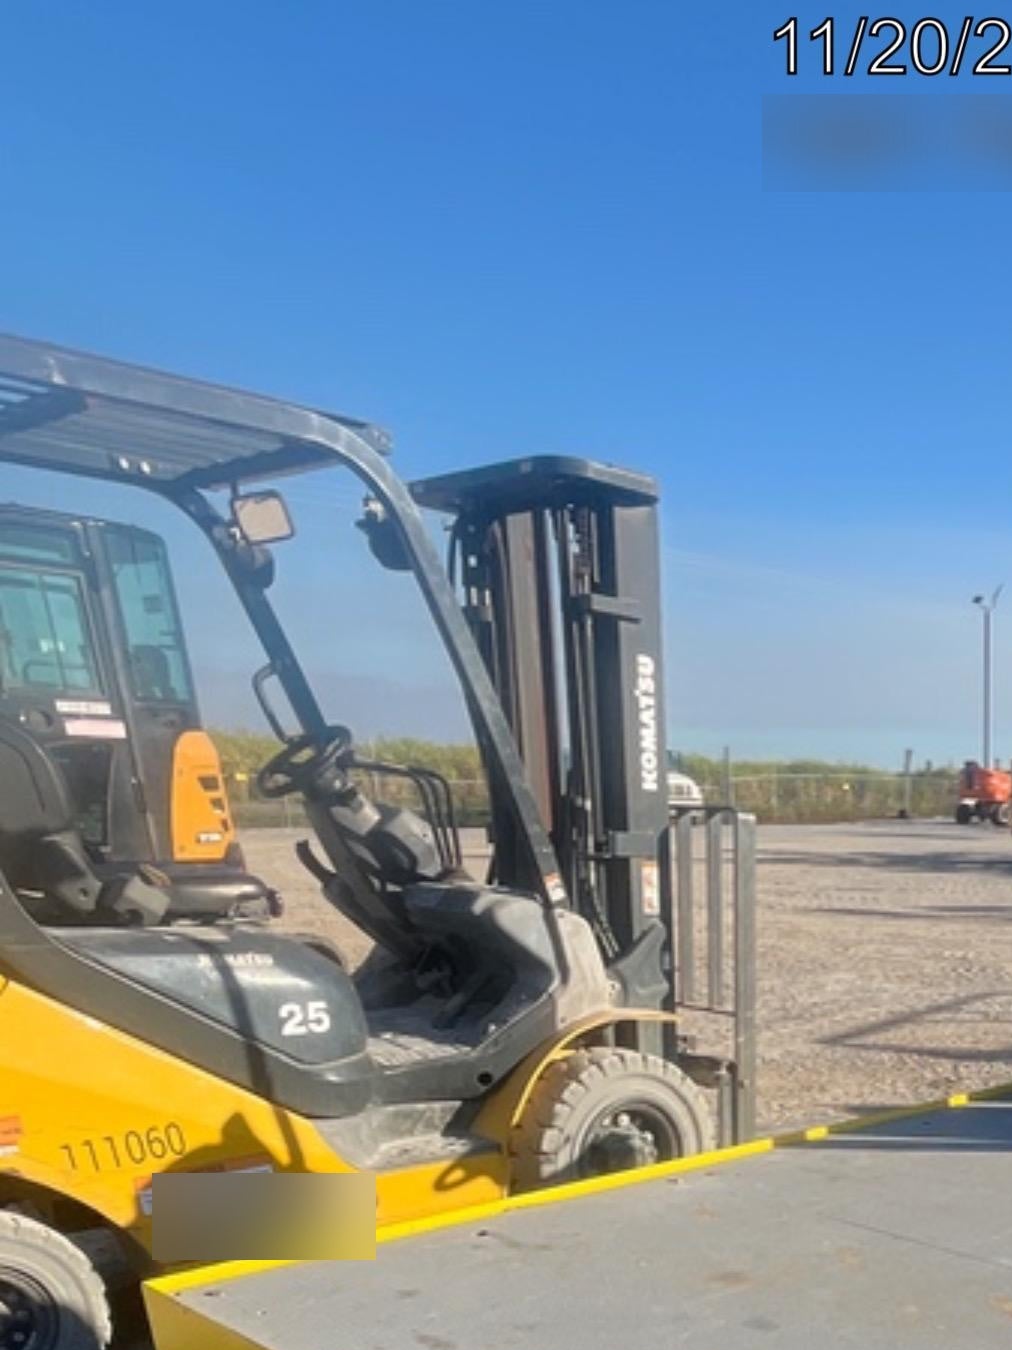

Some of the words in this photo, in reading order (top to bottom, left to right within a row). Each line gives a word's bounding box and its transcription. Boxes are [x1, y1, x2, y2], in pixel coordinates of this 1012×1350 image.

[635, 653, 658, 791] KOMATSU
[277, 1000, 332, 1036] 25
[60, 1122, 187, 1171] 111060
